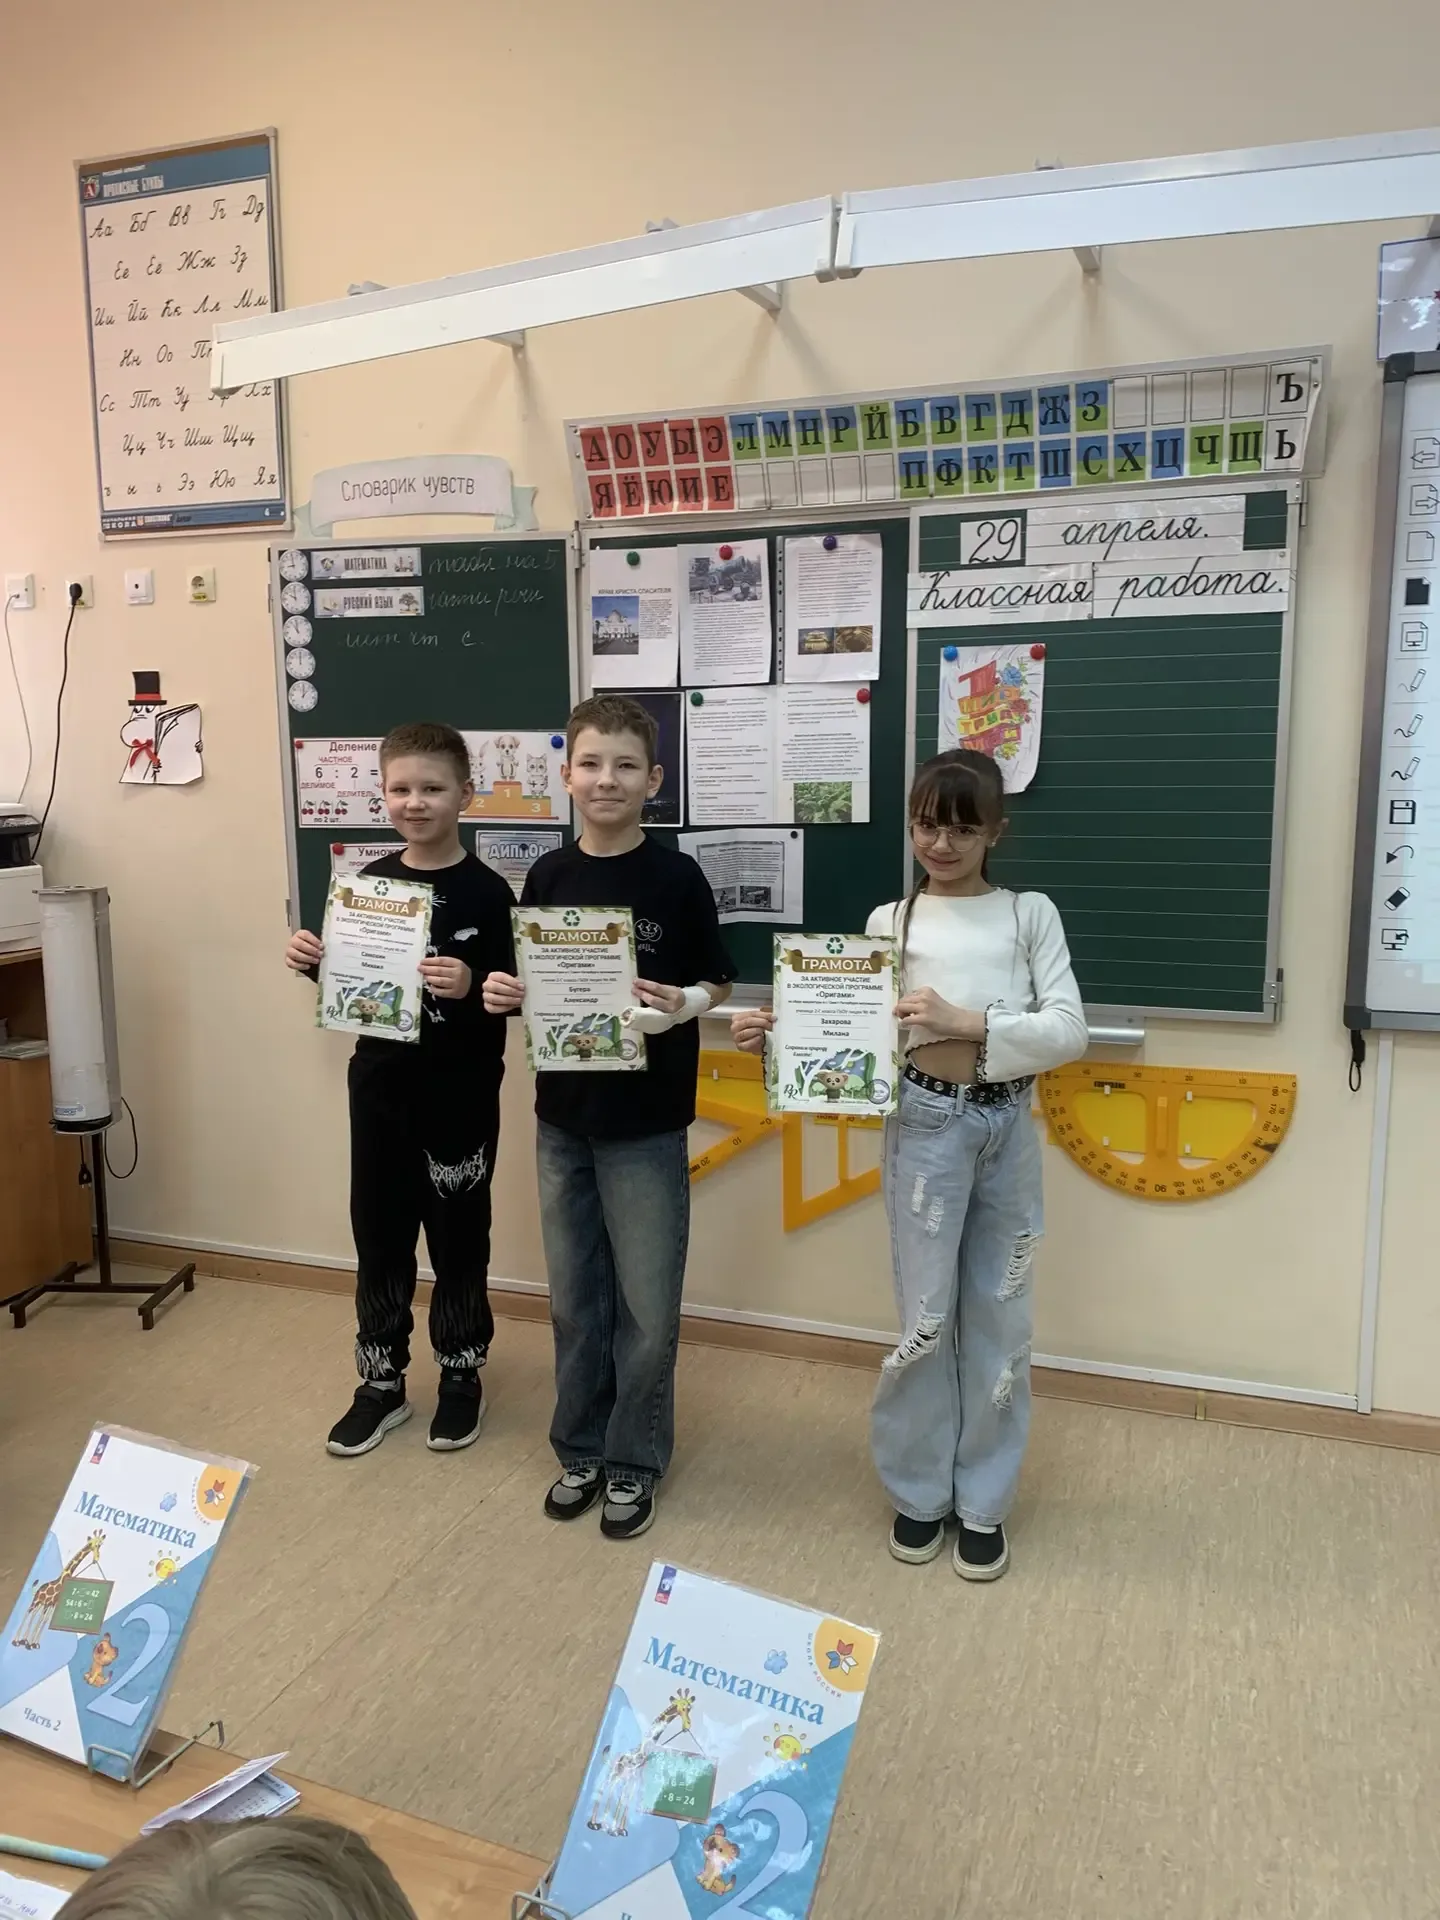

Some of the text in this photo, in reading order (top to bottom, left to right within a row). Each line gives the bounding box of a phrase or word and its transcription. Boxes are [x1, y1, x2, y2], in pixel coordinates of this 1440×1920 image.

[90, 195, 265, 238] Аа Бб Вв Гг Дд
[177, 251, 215, 272] Жж
[235, 289, 268, 309] Мм
[156, 344, 173, 363] Оо
[100, 394, 115, 413] Сс
[587, 373, 1303, 462] А О У Ы Э Л М Н Р Й Б В Г Д Ж З Ъ
[594, 430, 1296, 508] Я Ё Ю И Е П Ф К Т Ш С Х Ц Ч Щ Ь
[341, 475, 475, 503] Словарик чувств
[968, 515, 1209, 564] 29 апреля.
[344, 556, 387, 571] МАТЕМАТИКА
[919, 572, 1093, 610] Классная
[1110, 557, 1282, 616] работа.
[343, 590, 393, 609] РУССКИЙ ЯЗЫК
[329, 742, 377, 752] Деление
[316, 767, 323, 778] 6
[351, 767, 358, 778] 2
[504, 789, 510, 797] 1
[476, 799, 484, 807] 2
[532, 803, 540, 813] 3
[351, 897, 409, 914] ГРАМОТА
[540, 931, 609, 942] ГРАМОТА
[802, 959, 872, 971] ГРАМОТА
[1154, 1184, 1167, 1192] 90
[74, 1491, 197, 1549] Математика
[86, 1602, 171, 1727] 2
[642, 1636, 825, 1725] Математика
[23, 1707, 61, 1731] Часть 2
[706, 1790, 809, 1920] 2
